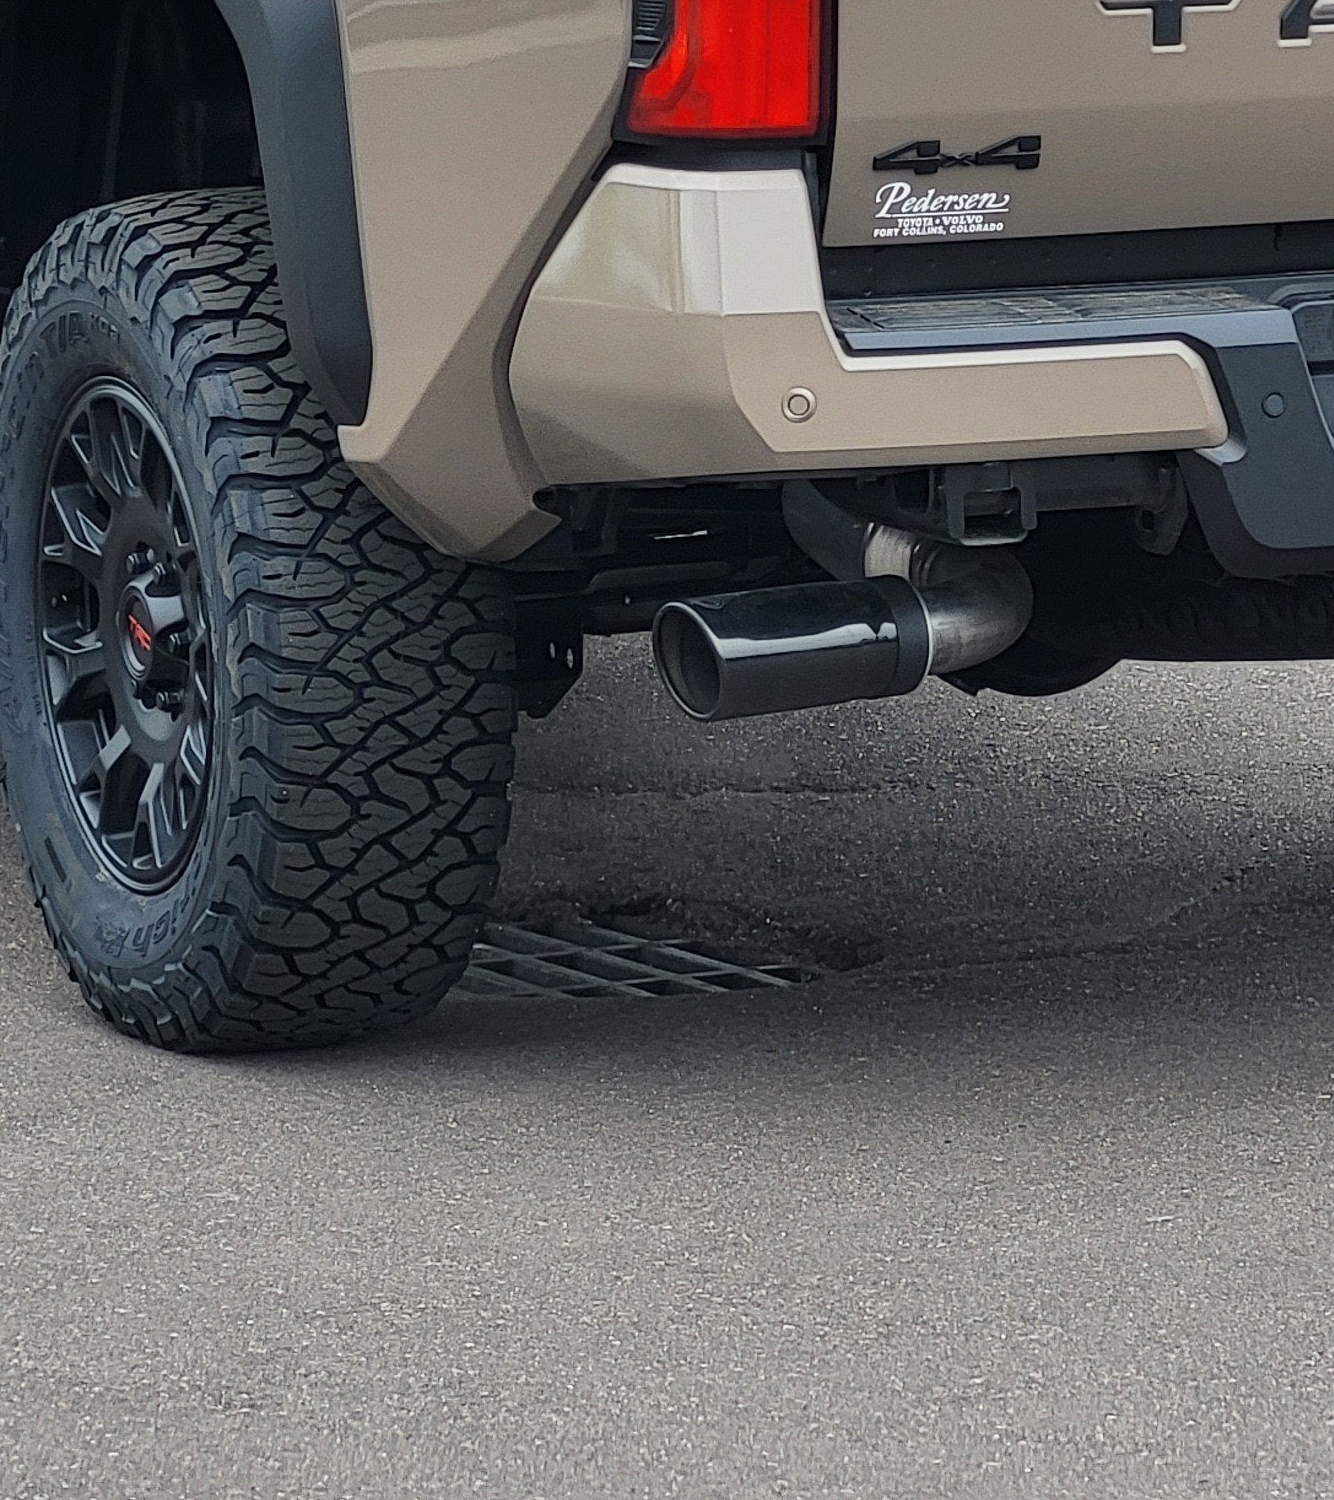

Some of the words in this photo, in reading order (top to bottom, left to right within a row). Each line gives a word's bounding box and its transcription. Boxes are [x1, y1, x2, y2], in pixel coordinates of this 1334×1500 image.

[875, 181, 1010, 218] Pedersen
[897, 217, 934, 229] TOYOTA
[942, 214, 984, 226] VOLVO
[873, 228, 900, 238] FORT
[949, 222, 1005, 234] COLORADO
